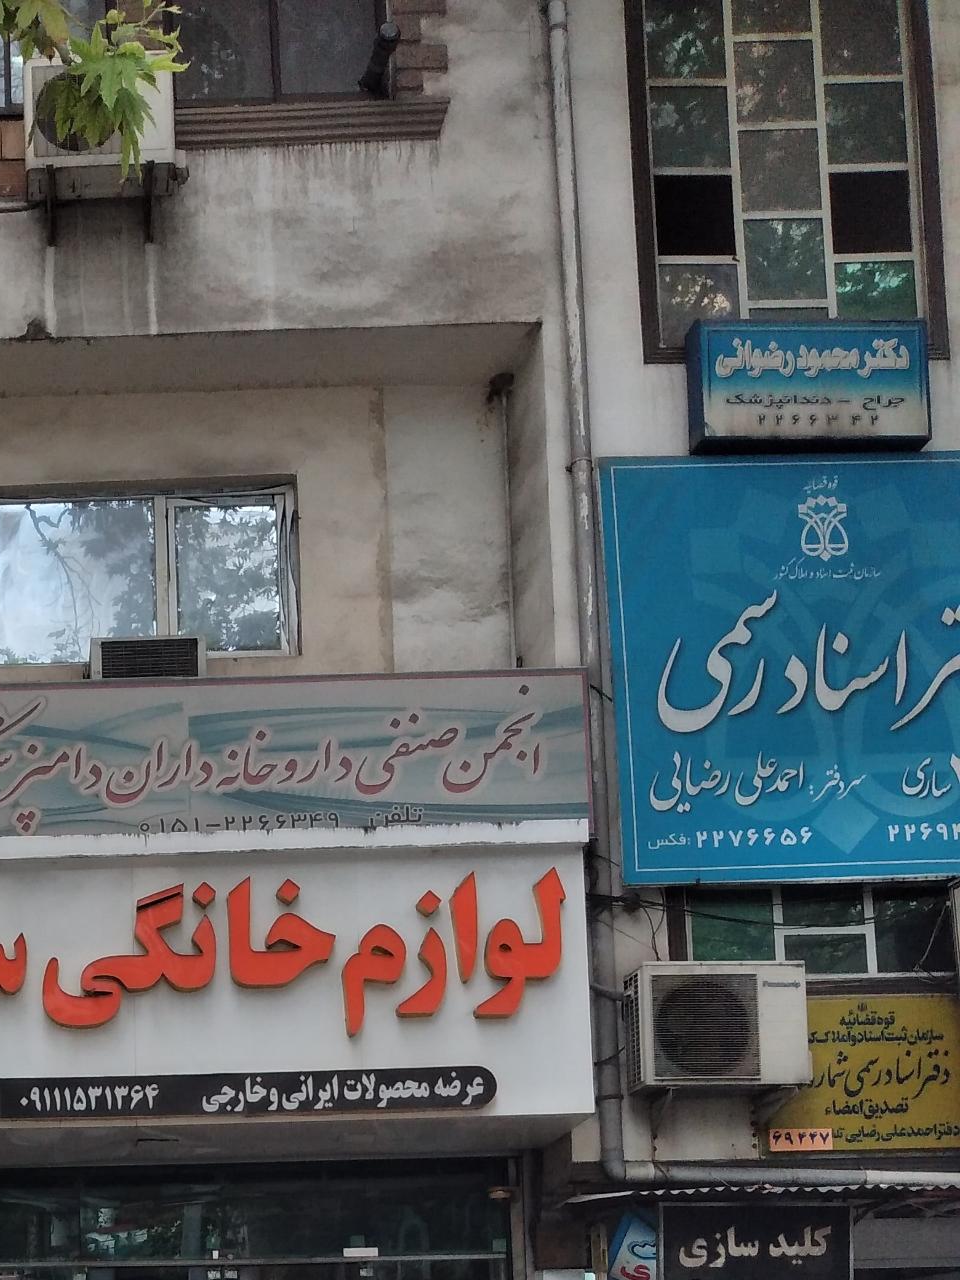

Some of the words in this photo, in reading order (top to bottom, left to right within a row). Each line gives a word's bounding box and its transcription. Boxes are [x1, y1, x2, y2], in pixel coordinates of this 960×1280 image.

[715, 337, 796, 378] رضوانی
[797, 344, 860, 378] محمود
[858, 337, 910, 378] دکتر
[726, 391, 832, 409] دندانپزشک
[863, 393, 905, 410] جراح
[657, 588, 778, 733] رسمی
[776, 622, 908, 715] اسناد
[354, 712, 459, 796] صنفی
[443, 684, 540, 794] انجمن
[902, 756, 952, 798] ساری
[695, 825, 813, 849] ۲۲۷۶۶۵۶
[43, 877, 337, 1030] خانگی
[342, 867, 566, 1039] لوازم
[282, 1073, 339, 1111] ایرانی
[343, 1073, 430, 1108] محصولات
[434, 1070, 485, 1105] عرضه
[844, 1056, 882, 1098] رسمی
[911, 1048, 951, 1100] دفتر
[19, 1083, 160, 1112] ۰۹۱۱۱۵۳۱۳۶۴
[863, 1097, 909, 1119] تصدیق
[678, 1226, 759, 1268] سازی
[768, 1225, 832, 1265] کلید
